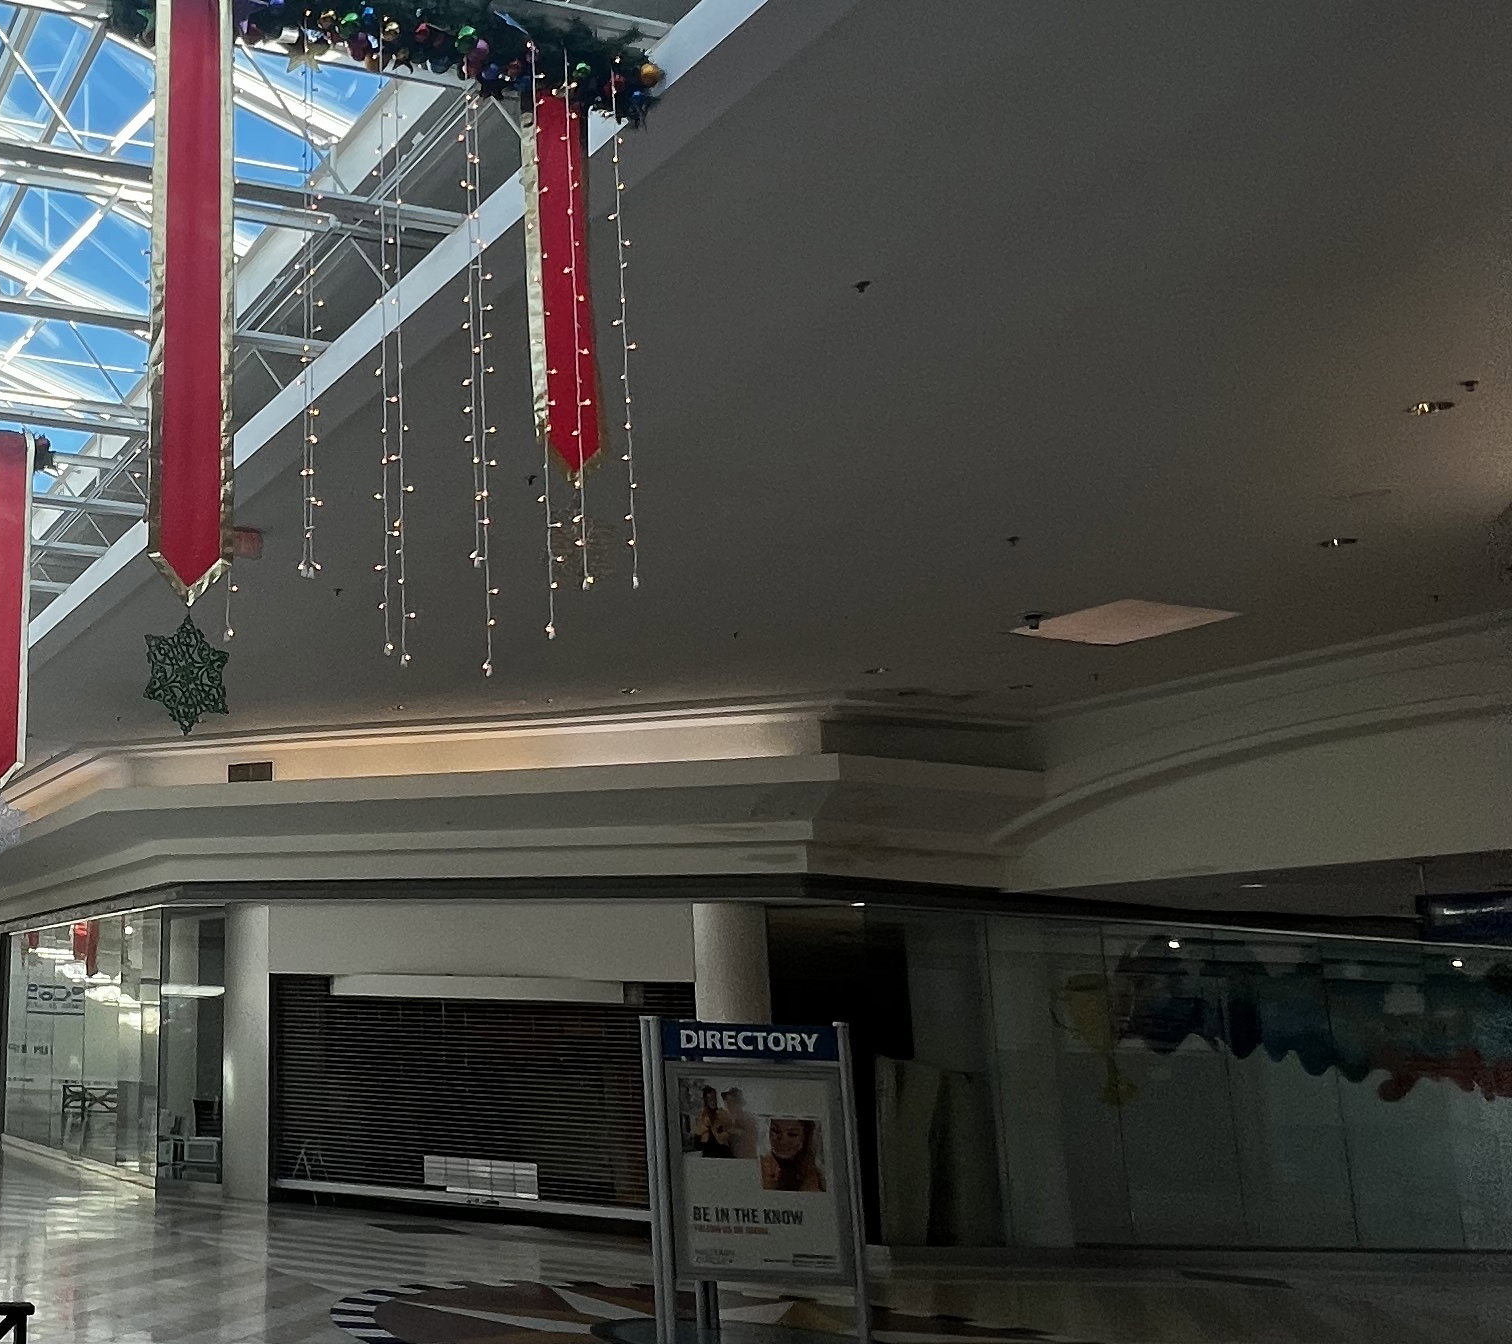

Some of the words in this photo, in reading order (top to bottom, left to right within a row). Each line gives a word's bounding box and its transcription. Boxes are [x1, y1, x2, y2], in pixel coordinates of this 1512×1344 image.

[680, 1029, 819, 1052] DIRECTORY
[693, 1206, 711, 1222] BE
[715, 1207, 730, 1223] IN
[734, 1208, 759, 1224] THE
[763, 1209, 804, 1225] KNOW
